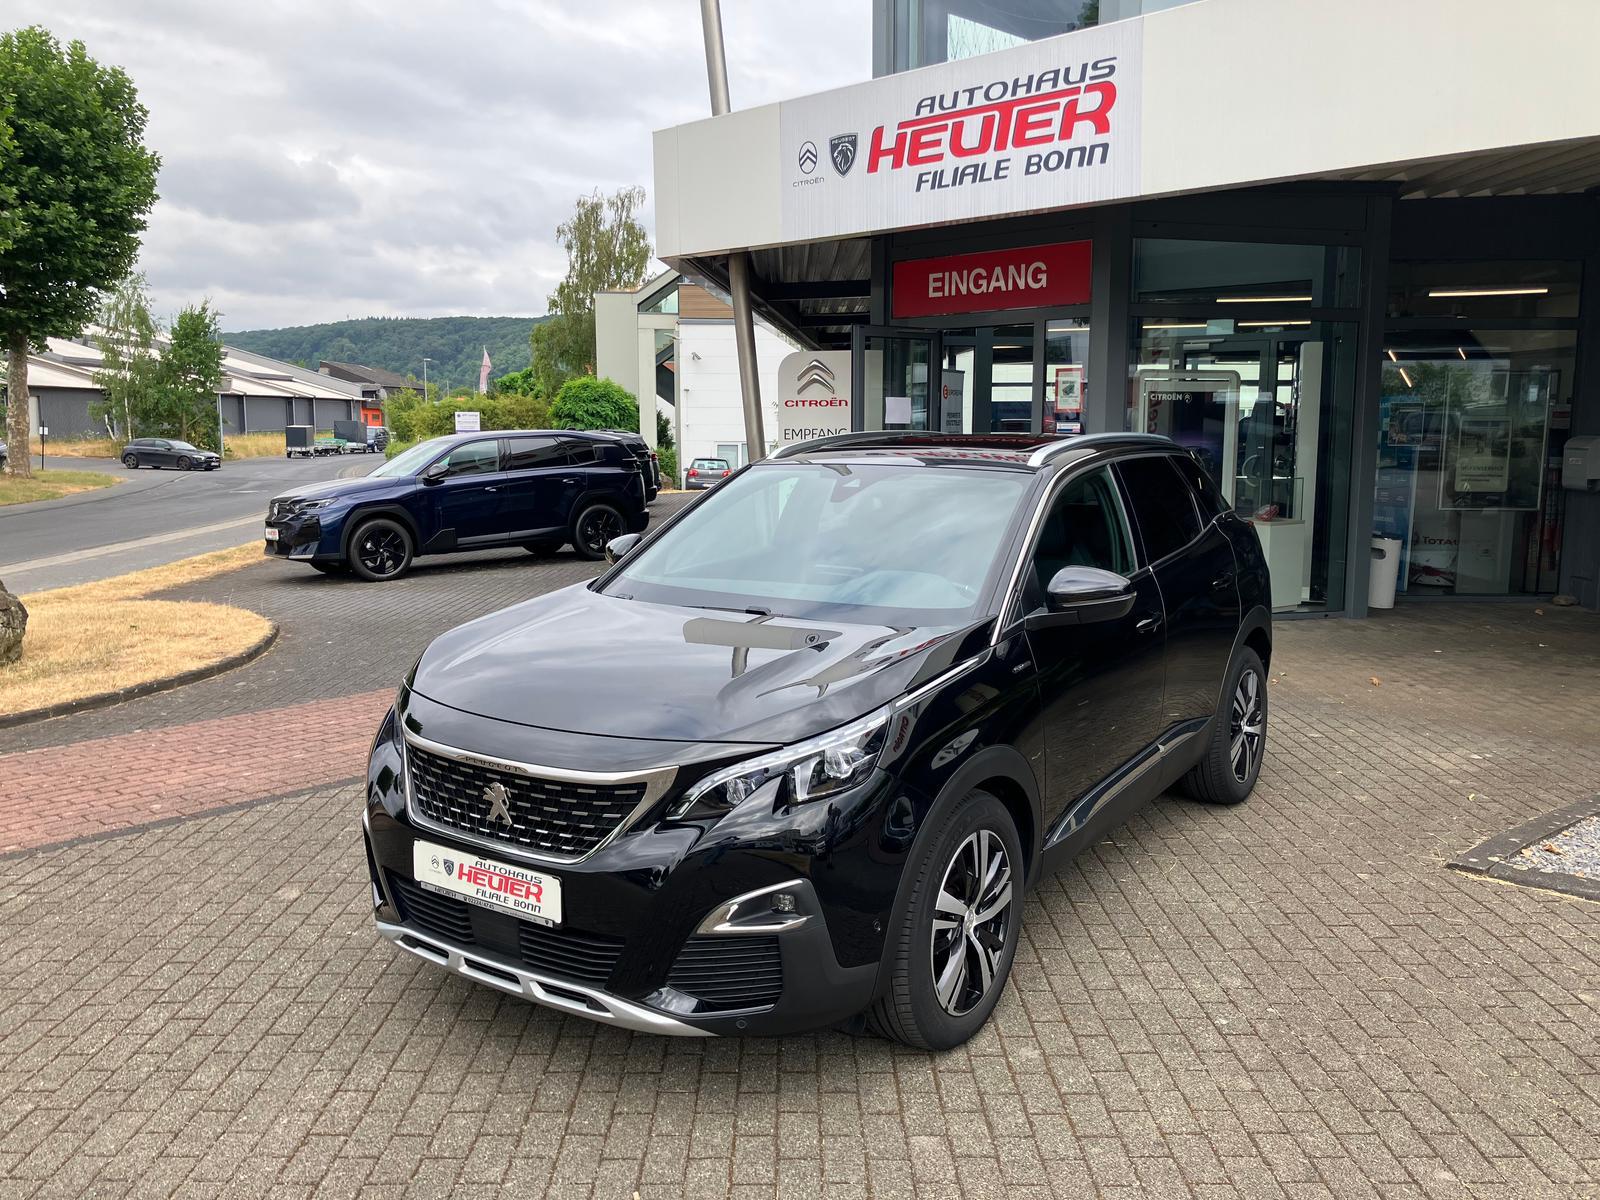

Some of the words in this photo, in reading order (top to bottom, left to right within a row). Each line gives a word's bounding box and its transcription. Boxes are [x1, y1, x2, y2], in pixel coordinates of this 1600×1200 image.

[915, 57, 1117, 117] AUTOHAUS
[832, 136, 856, 145] PEUGEOT
[867, 81, 1118, 174] HEUTER
[915, 158, 1010, 192] FILIALE
[1024, 143, 1110, 177] BONN
[928, 261, 1048, 298] EINGANG
[784, 397, 849, 408] CITROËN
[465, 756, 520, 773] PEUGEOT
[457, 863, 543, 903] HEUTER
[474, 860, 543, 884] AUTOHAUS
[475, 887, 510, 905] FILIALE
[513, 899, 542, 914] BONN
